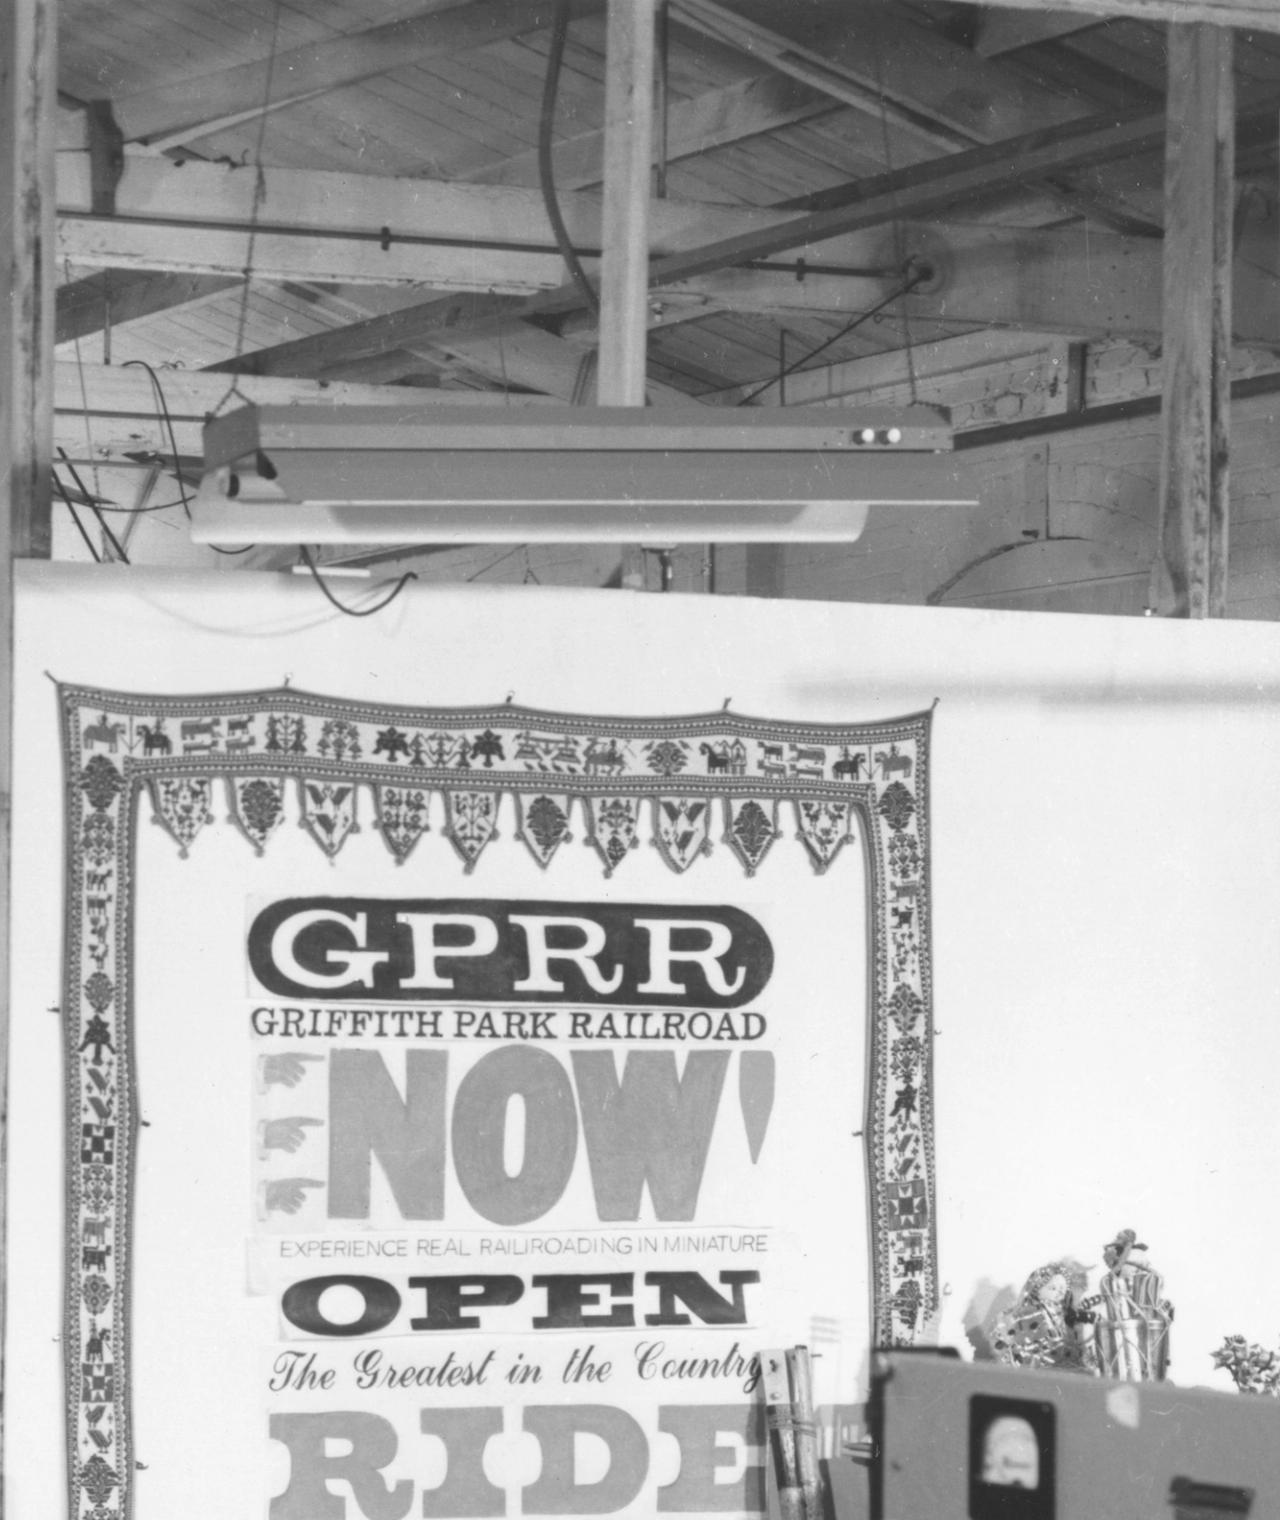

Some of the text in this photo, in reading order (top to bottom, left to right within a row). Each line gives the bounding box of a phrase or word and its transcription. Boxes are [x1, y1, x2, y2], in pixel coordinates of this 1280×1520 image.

[270, 907, 747, 998] GPRR
[251, 1009, 768, 1041] GRIFFITH PARK RAILROAD
[279, 1239, 409, 1259] EXPERIENCE
[416, 1238, 472, 1257] REAL
[638, 1236, 658, 1253] IN
[663, 1234, 769, 1253] MINIATURE
[280, 1269, 761, 1337] OPEN
[268, 1340, 762, 1395] The Greatest in the Country
